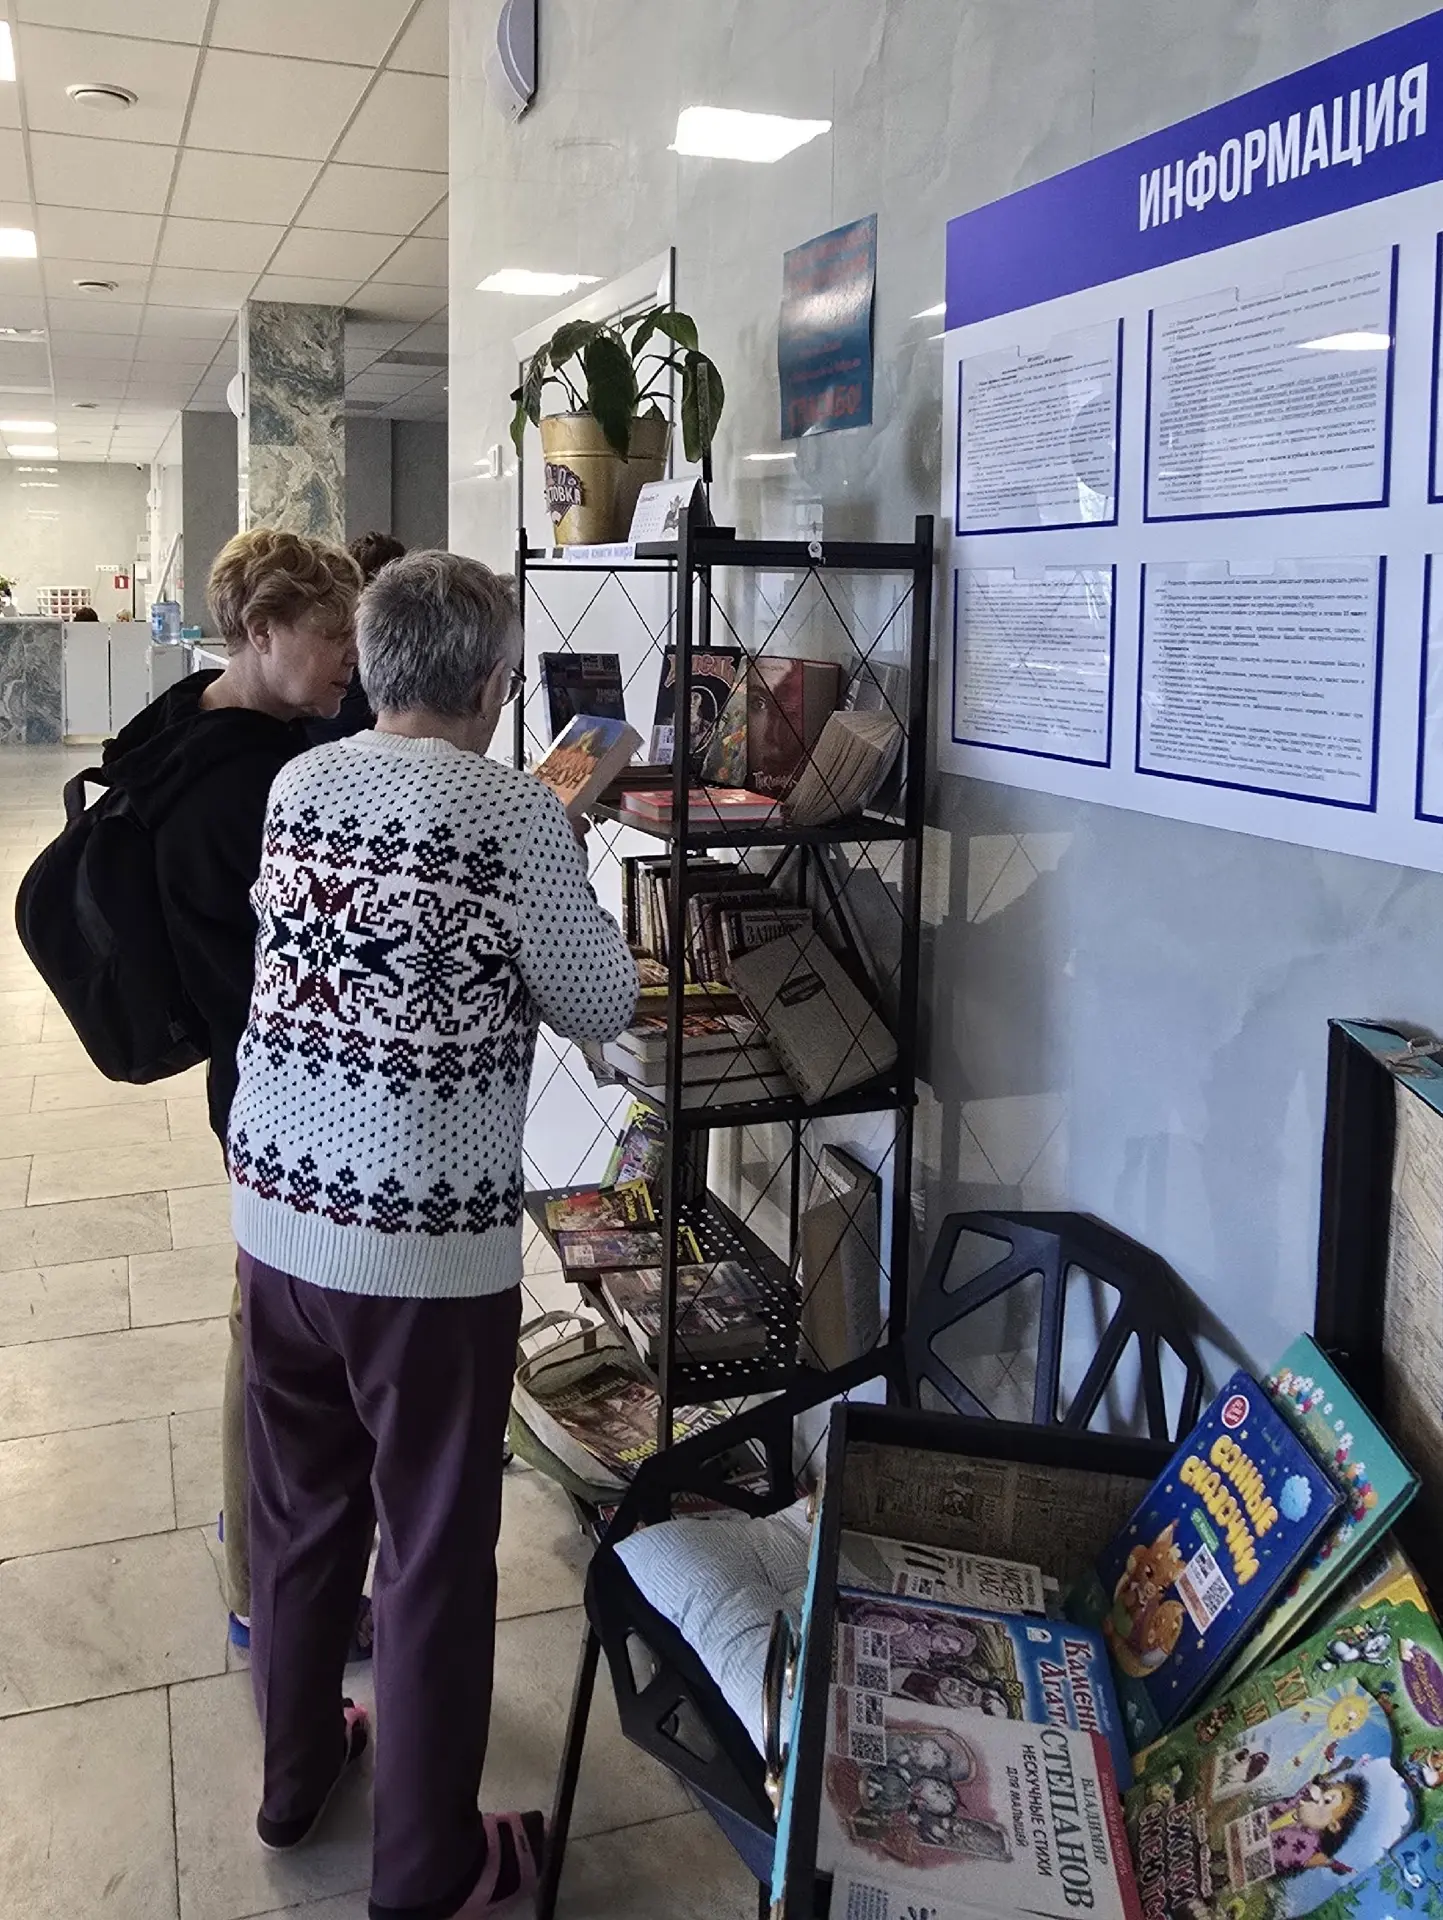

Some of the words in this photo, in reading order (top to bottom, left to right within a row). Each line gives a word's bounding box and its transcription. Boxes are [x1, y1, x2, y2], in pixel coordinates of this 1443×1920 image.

[1139, 62, 1428, 232] ИНФОРМАЦИЯ
[1006, 1766, 1021, 1791] ДЛЯ
[1022, 1744, 1046, 1825] НЕСКУЧНЫЕ
[1040, 1729, 1094, 1909] СТЕПАНОВ
[1011, 1791, 1029, 1848] МАЛЫШЕЙ
[1032, 1827, 1053, 1877] СТИХИ
[1081, 1777, 1108, 1865] ВЛАДИМИР
